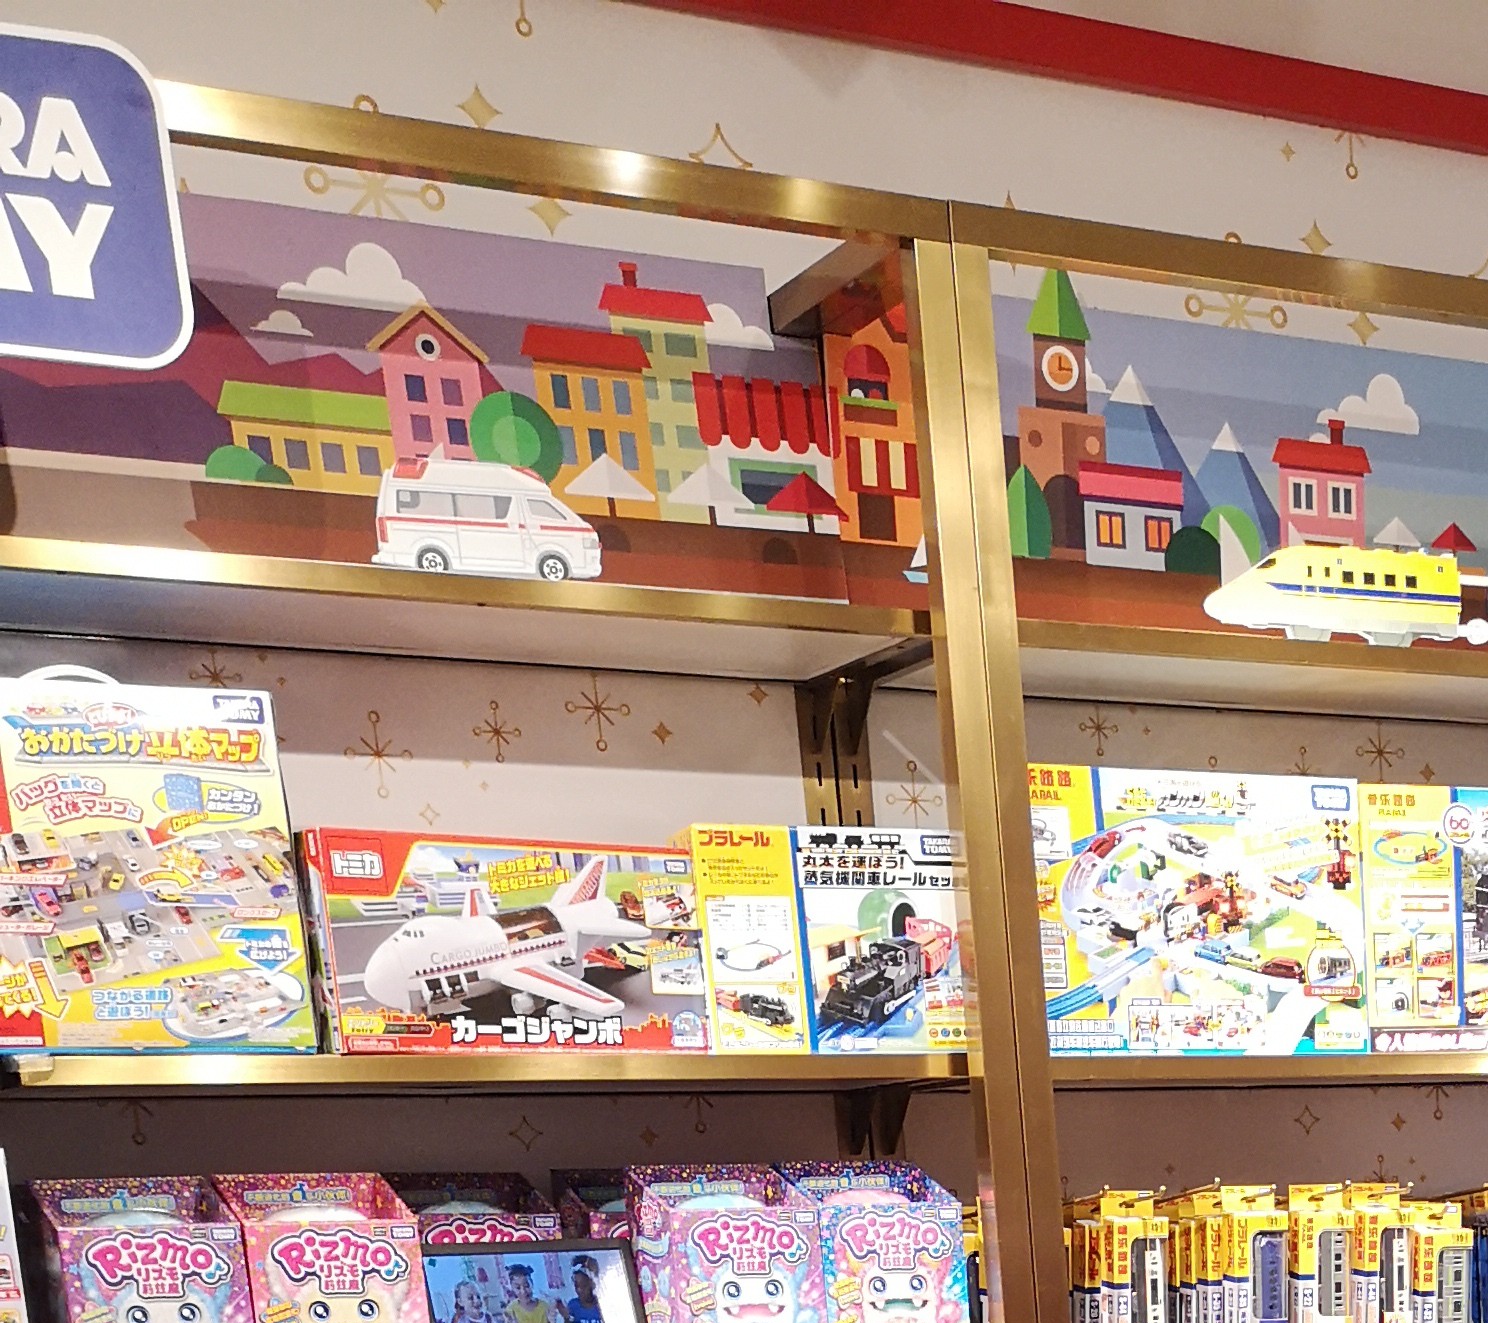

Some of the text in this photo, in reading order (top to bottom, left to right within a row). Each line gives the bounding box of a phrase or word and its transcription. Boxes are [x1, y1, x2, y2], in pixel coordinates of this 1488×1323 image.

[697, 829, 771, 848] プラレール
[333, 852, 383, 878] トミカ
[803, 854, 906, 869] 丸太を運ぼう!
[452, 1014, 623, 1046] カーゴジャンボ
[699, 1220, 797, 1258] Rizmo
[845, 1217, 938, 1255] Rizmo
[92, 1237, 214, 1280] Rizmo
[278, 1235, 392, 1276] Rizmo
